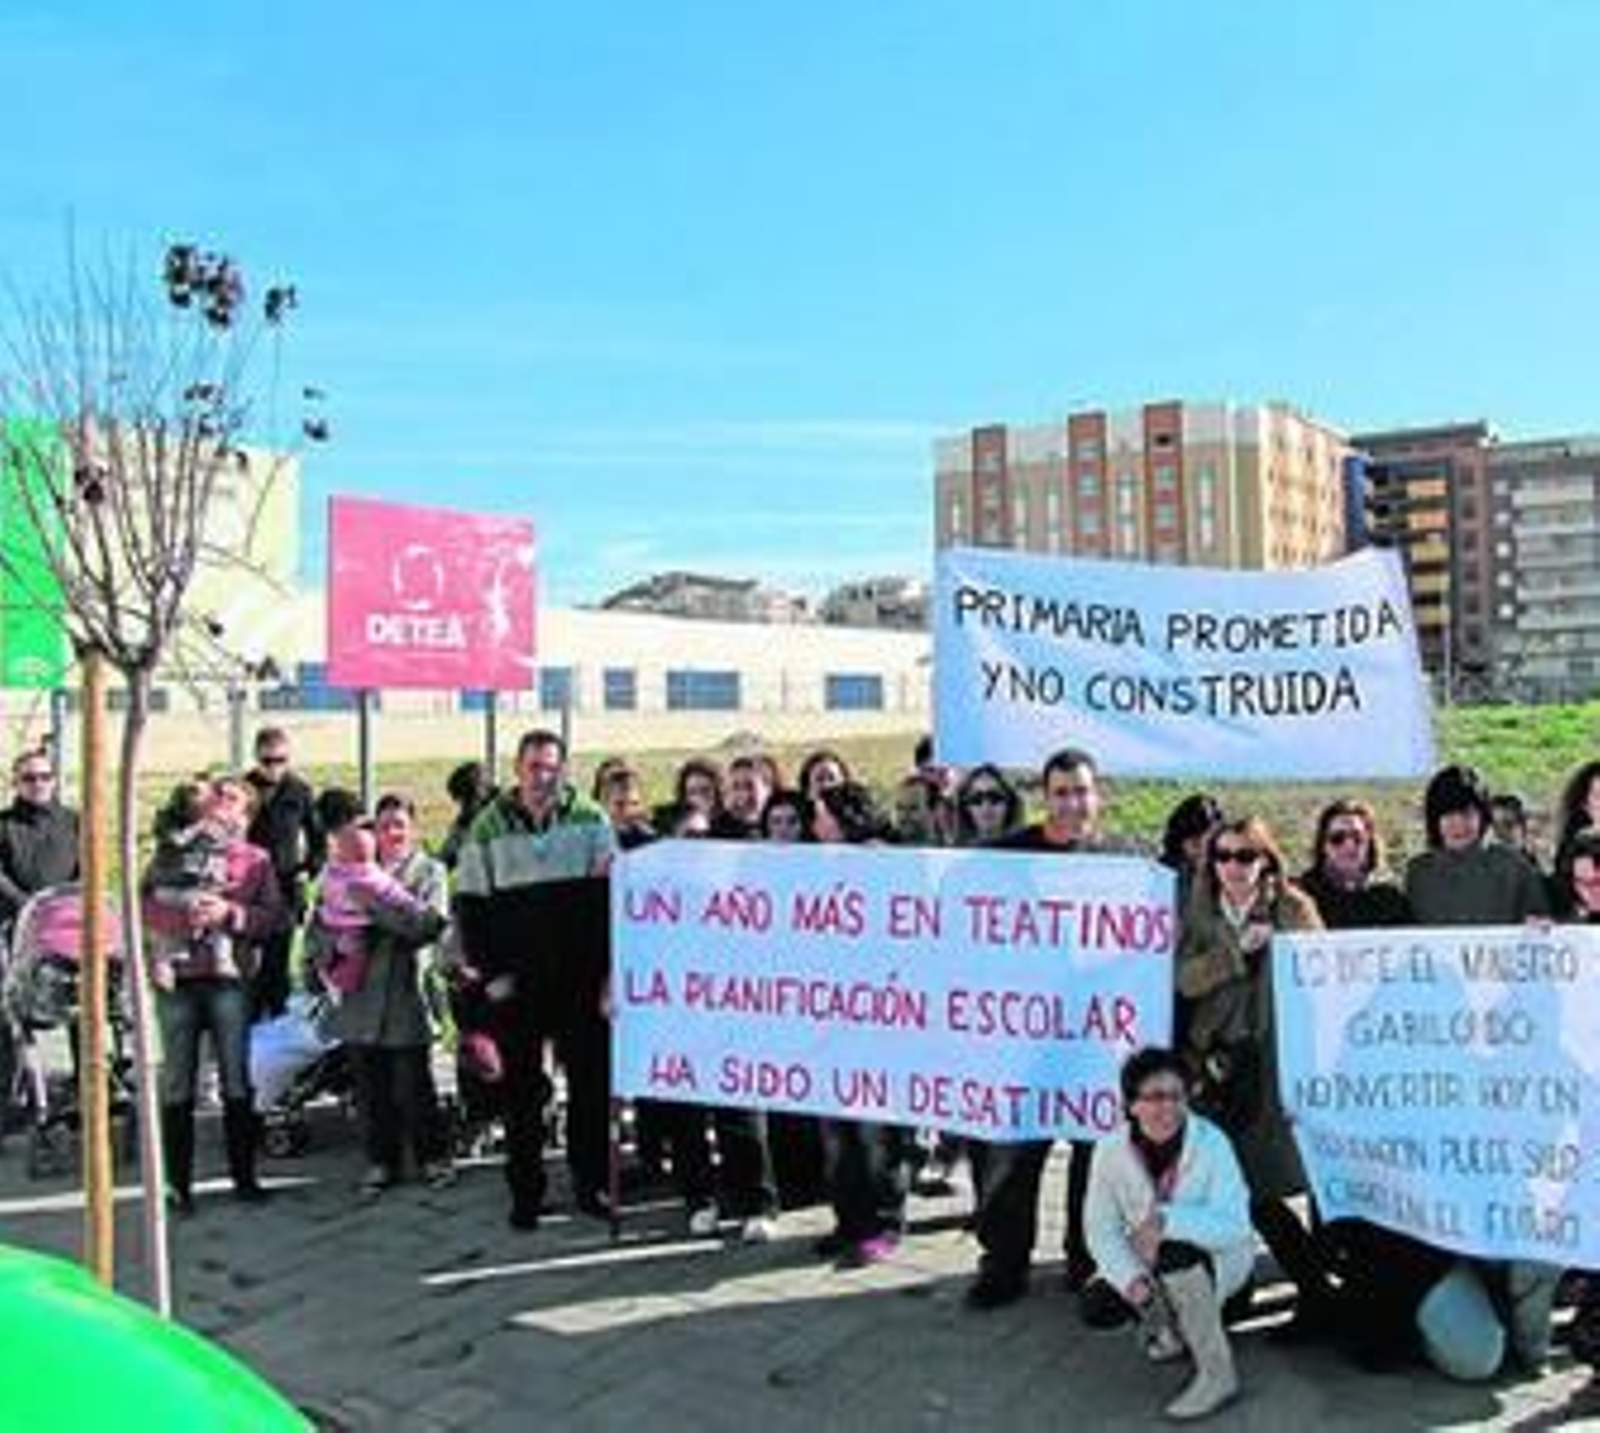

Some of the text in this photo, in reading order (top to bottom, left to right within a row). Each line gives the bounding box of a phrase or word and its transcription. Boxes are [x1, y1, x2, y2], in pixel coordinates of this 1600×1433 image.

[955, 585, 1402, 654] PRIMARIA PROMETIDA
[1085, 666, 1361, 717] CONSTRUIDA
[625, 884, 1171, 955] UN AÑO MÁS EN TEATINOS
[625, 970, 1136, 1046] LA PLANIFICACIÓN ESCOLAR
[719, 1056, 811, 1100] SIDO
[833, 1067, 888, 1108] UN
